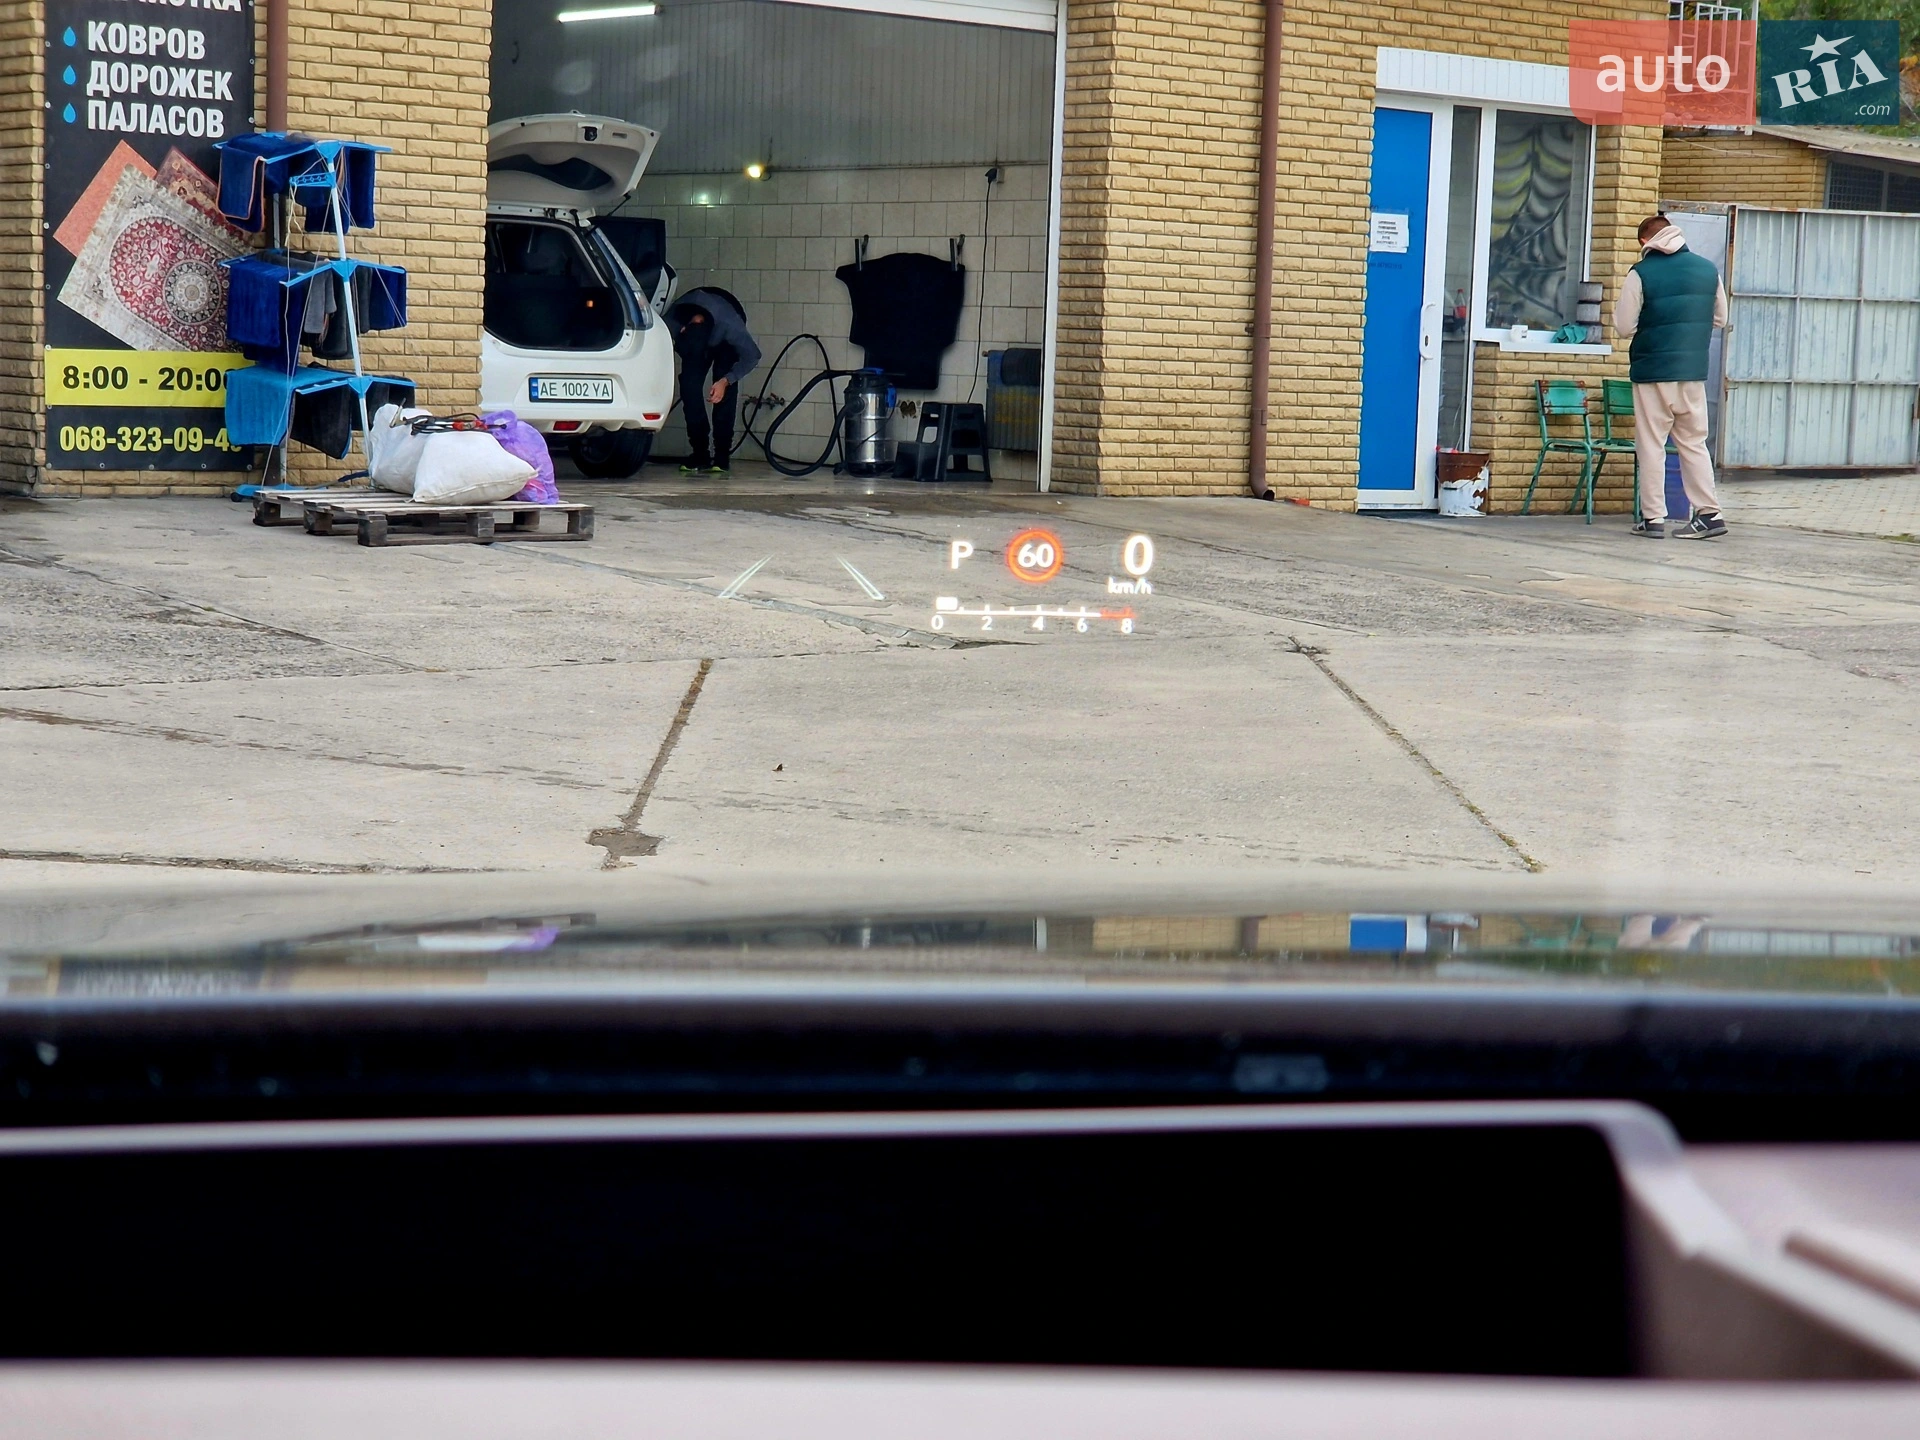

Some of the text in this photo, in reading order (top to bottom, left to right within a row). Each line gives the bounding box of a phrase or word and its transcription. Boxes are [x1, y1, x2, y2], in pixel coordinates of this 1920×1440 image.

[87, 20, 206, 60] КОВРОВ
[86, 60, 234, 101] ДОРОЖЕК
[87, 99, 225, 138] ПАЛАСОВ
[62, 365, 129, 390] 8:00
[540, 382, 610, 397] AE 1002 YA
[59, 425, 243, 453] 068-323-09-4
[950, 541, 974, 570] P
[1017, 543, 1055, 569] 60
[1123, 535, 1154, 576] 0
[1107, 576, 1153, 596] km/h
[931, 615, 1133, 634] 0 2 4 6 8
